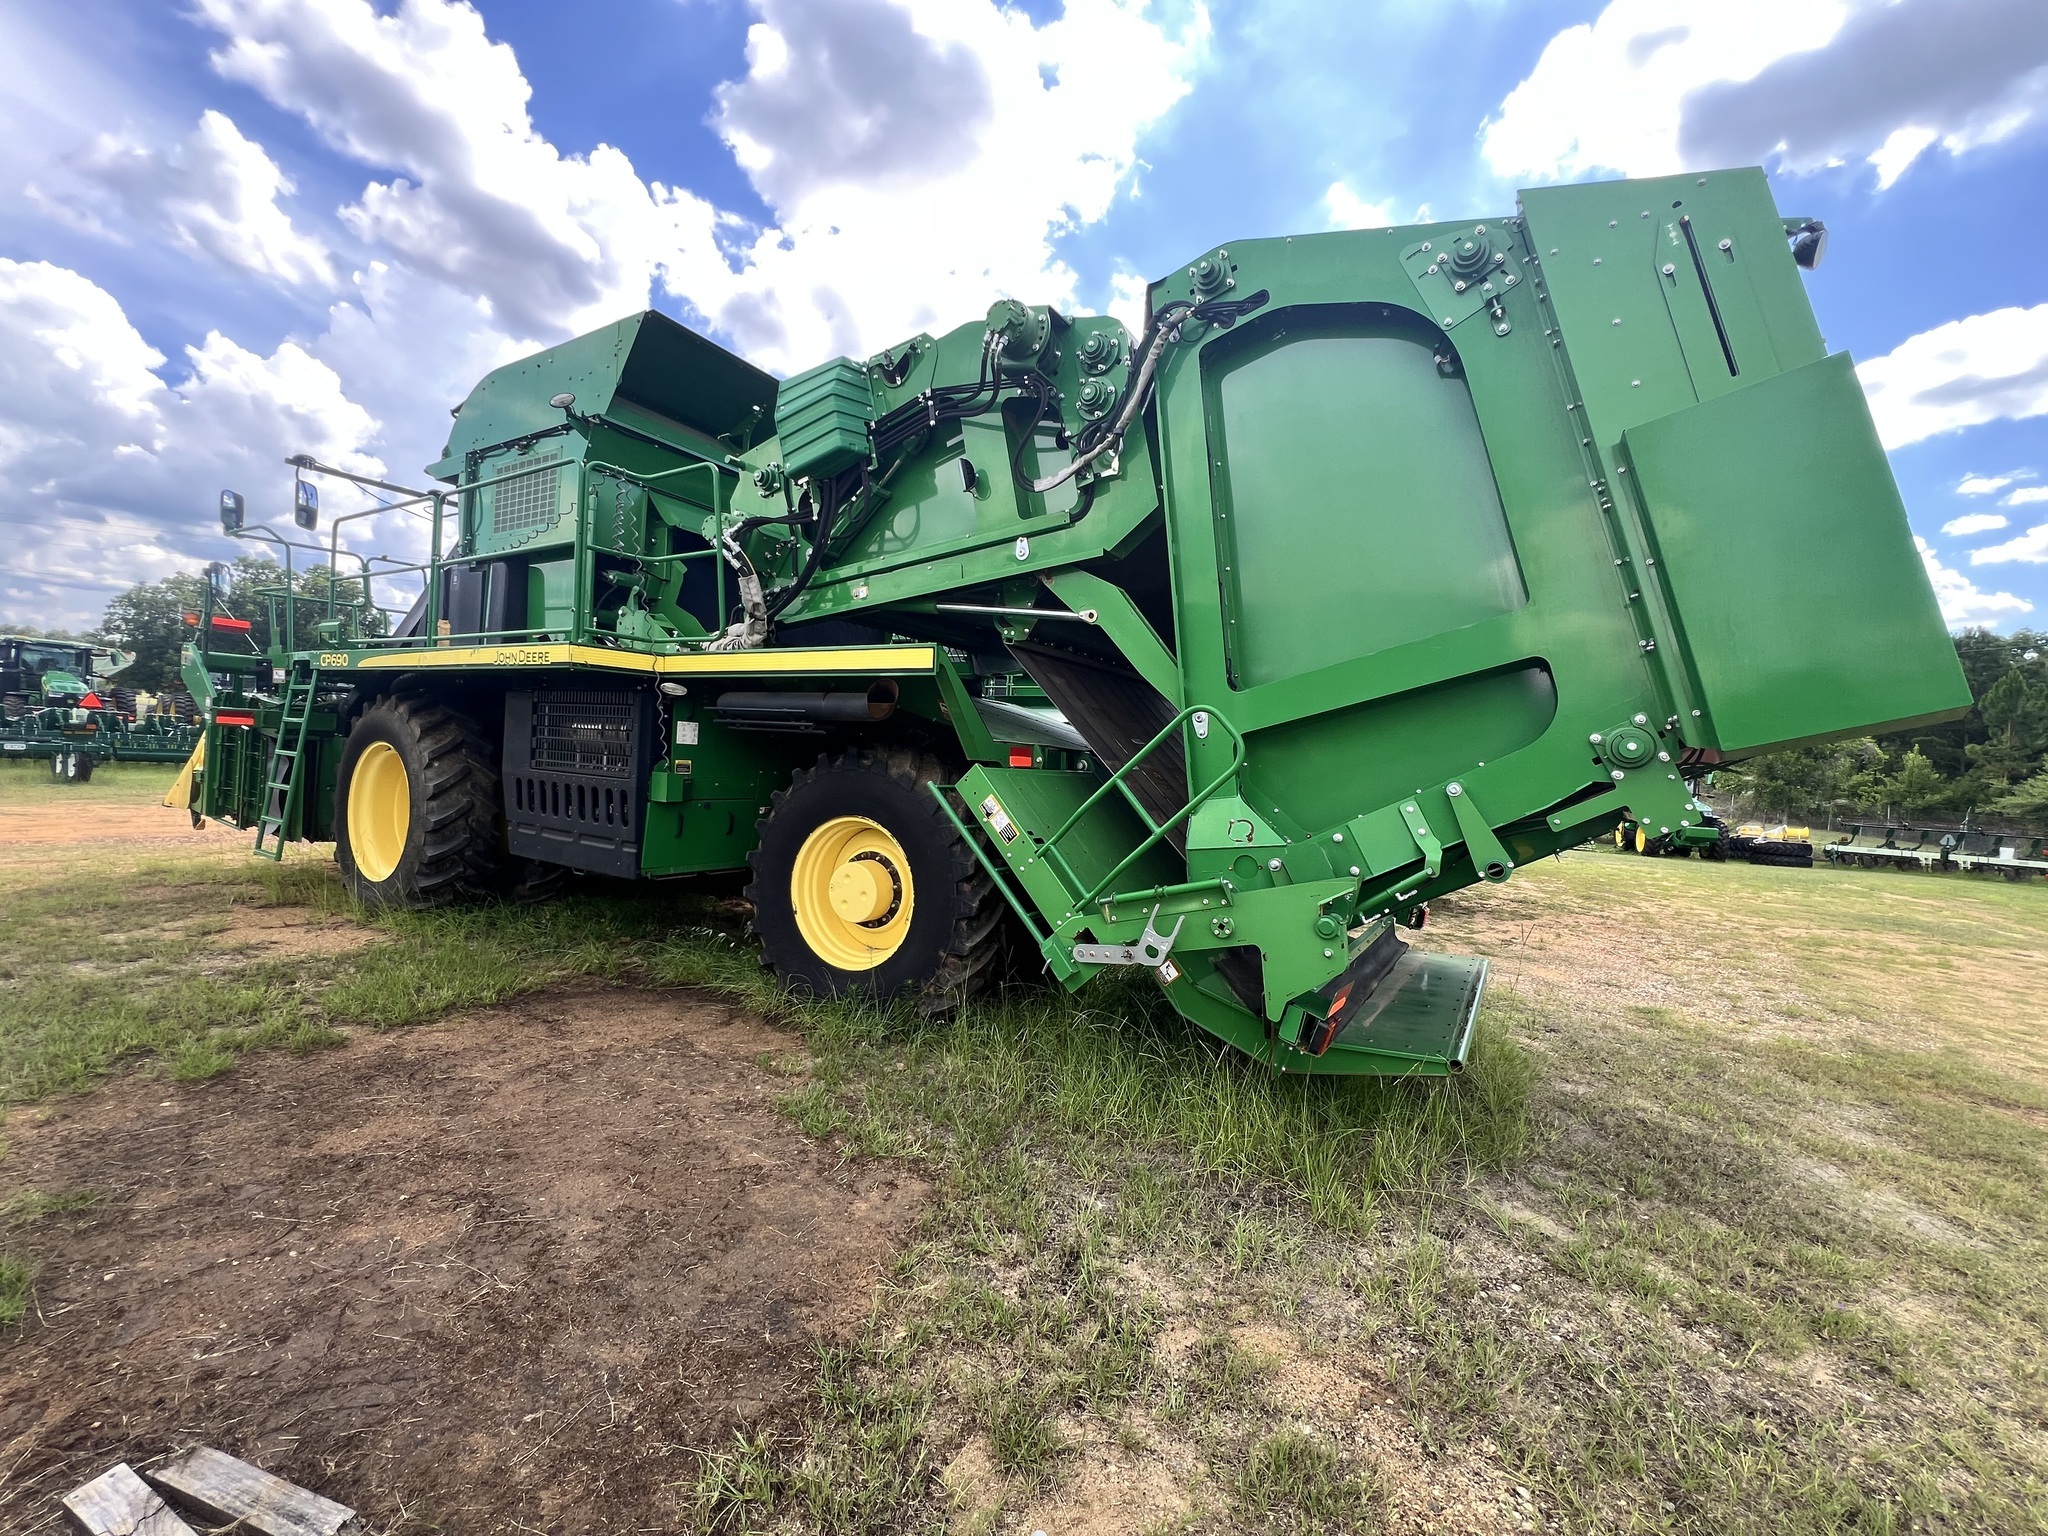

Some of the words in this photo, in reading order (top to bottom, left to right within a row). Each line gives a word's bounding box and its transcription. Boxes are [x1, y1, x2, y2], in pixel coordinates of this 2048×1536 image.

[320, 653, 349, 667] CP690
[493, 650, 518, 664] JOHN
[518, 649, 550, 664] DEERE
